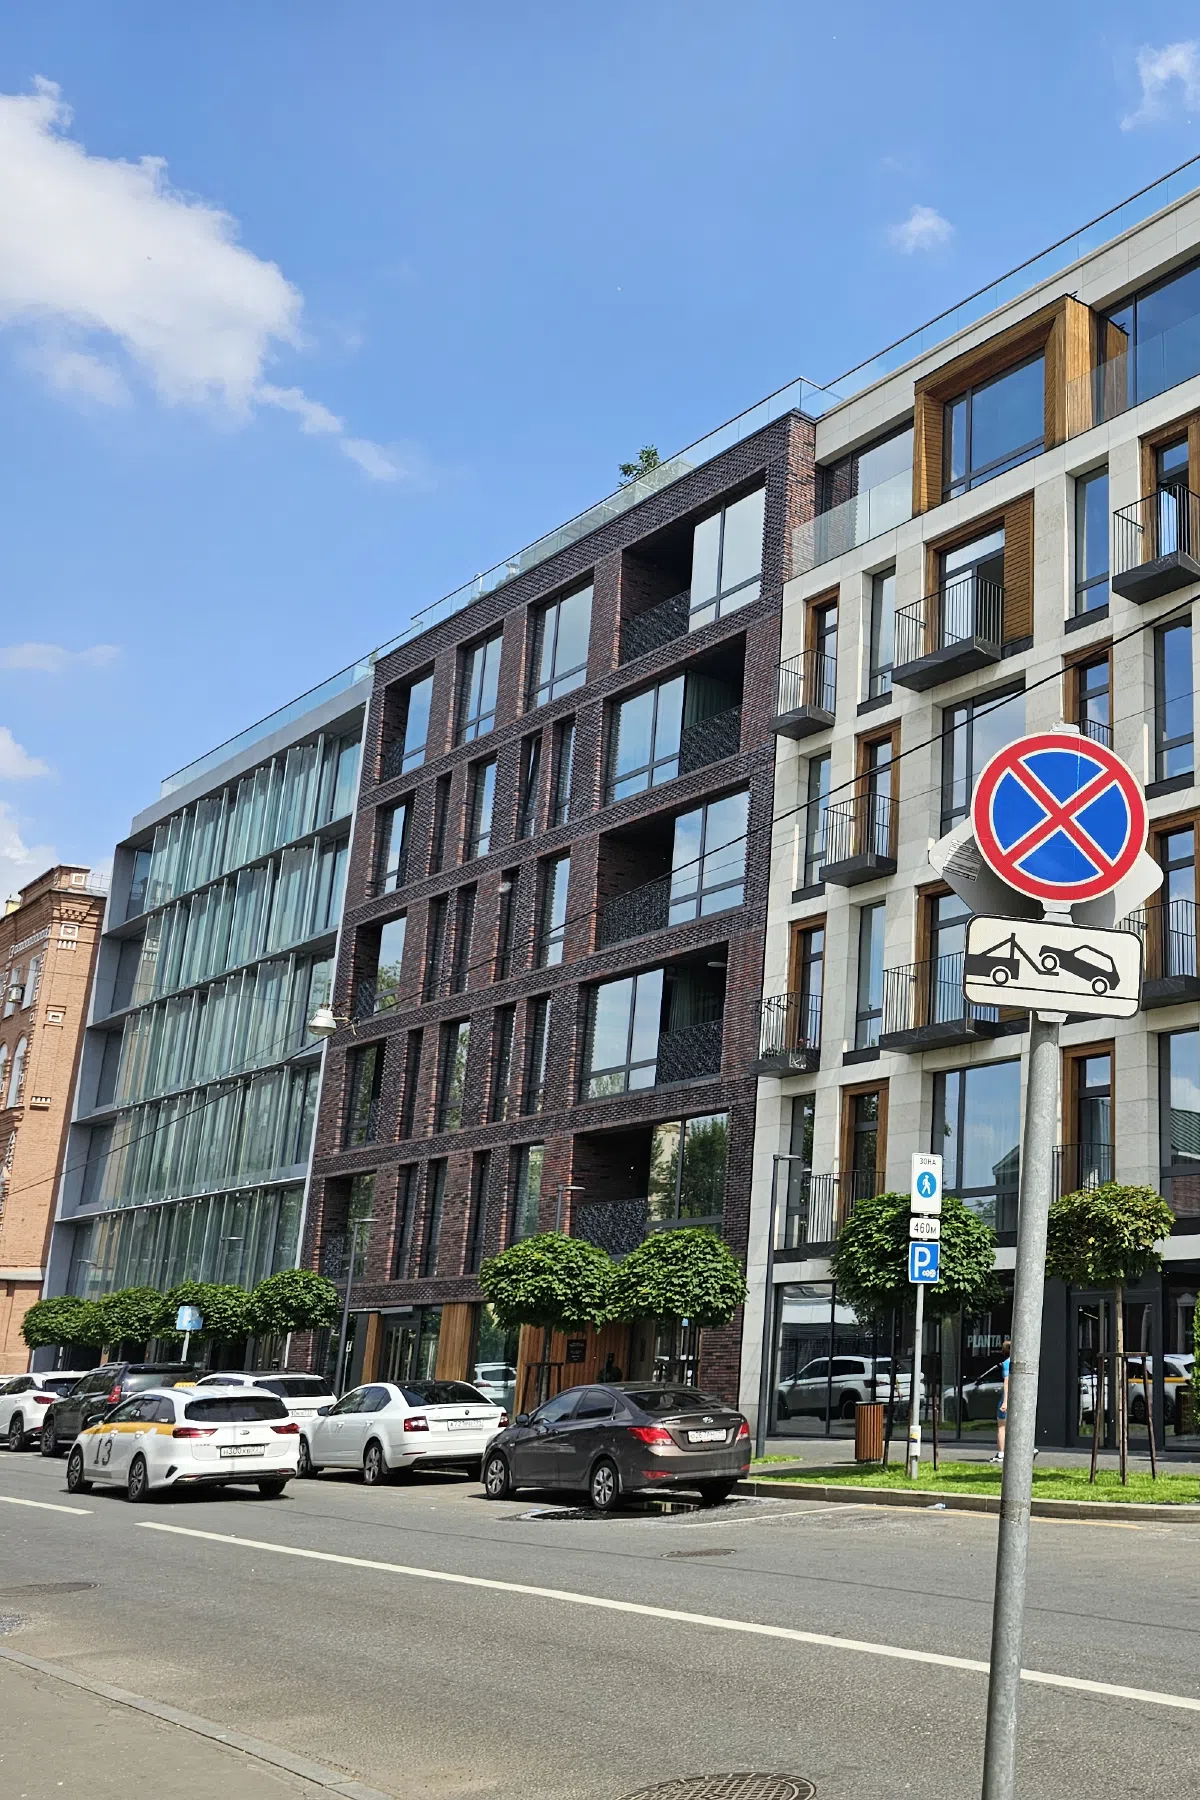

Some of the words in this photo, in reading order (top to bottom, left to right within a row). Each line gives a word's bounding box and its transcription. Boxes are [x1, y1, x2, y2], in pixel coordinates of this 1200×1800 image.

[919, 1157, 937, 1166] ЗОНА
[913, 1246, 931, 1278] P
[967, 1335, 1002, 1348] PLANTA
[93, 1437, 113, 1466] 13
